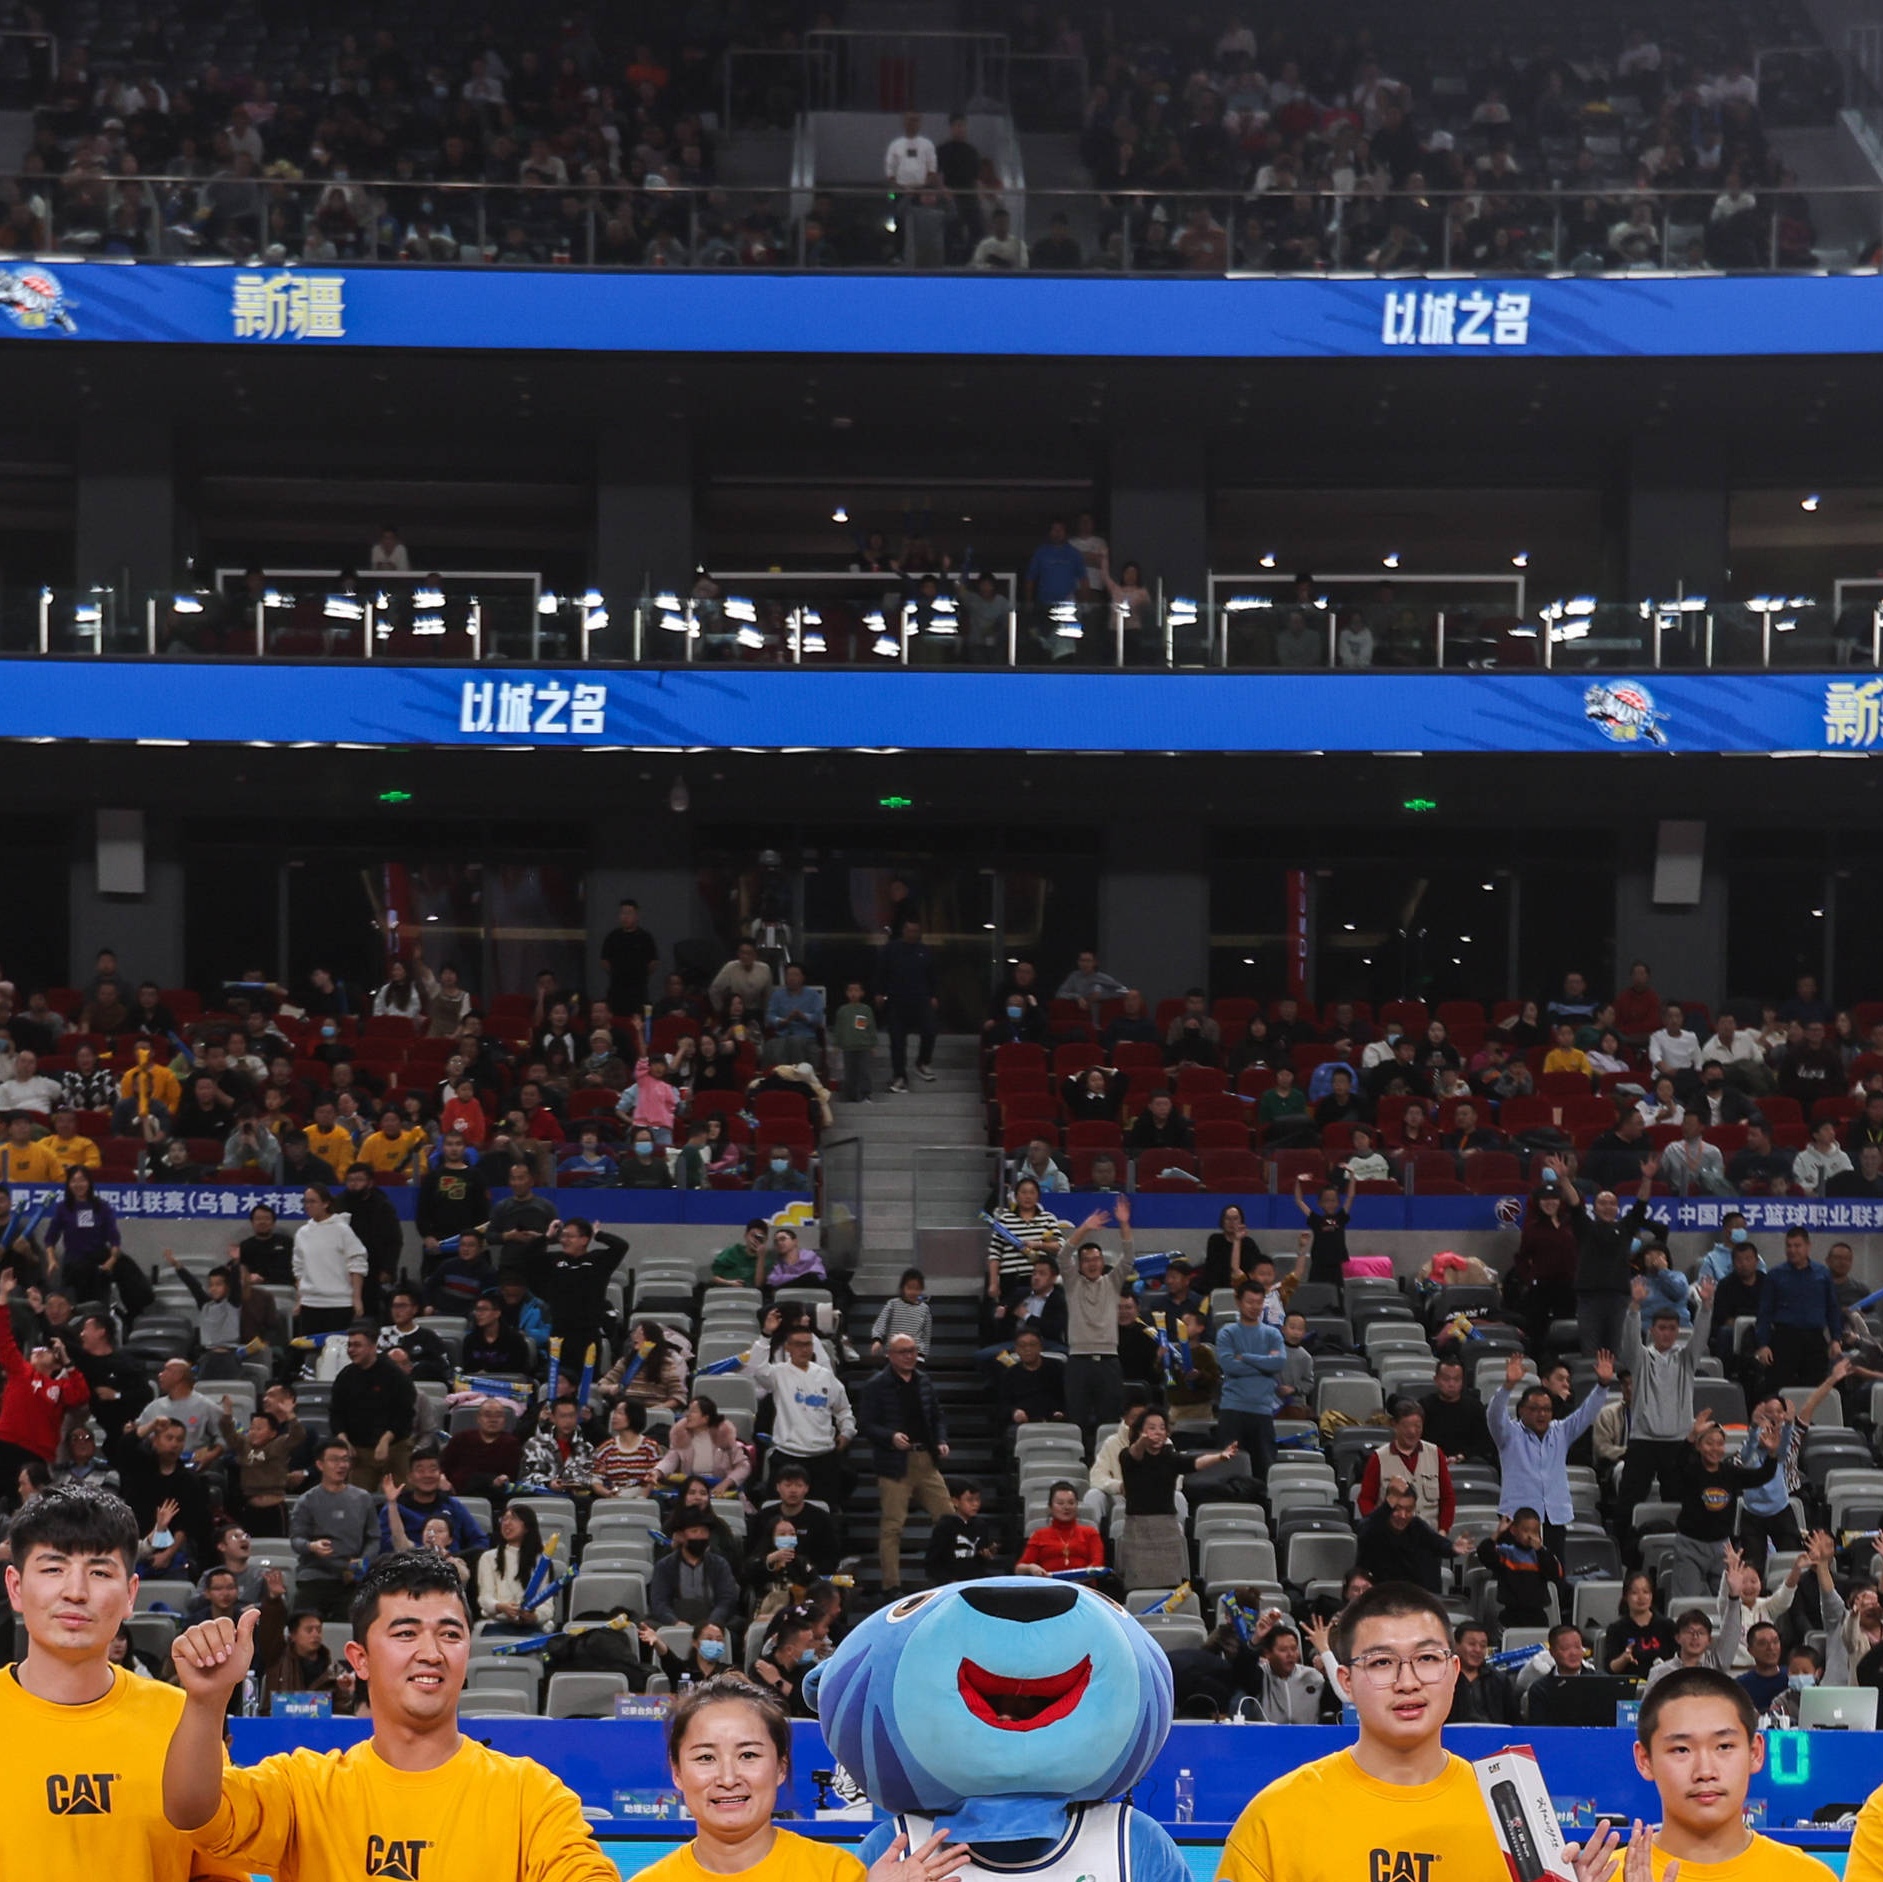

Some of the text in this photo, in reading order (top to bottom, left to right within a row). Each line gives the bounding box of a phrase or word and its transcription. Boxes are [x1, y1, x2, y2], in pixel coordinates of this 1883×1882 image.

[231, 272, 346, 340] 新疆
[1381, 290, 1532, 346] 以城之名
[459, 680, 607, 734] 以城之名
[46, 1774, 114, 1815] CAT
[366, 1834, 427, 1882] CAT
